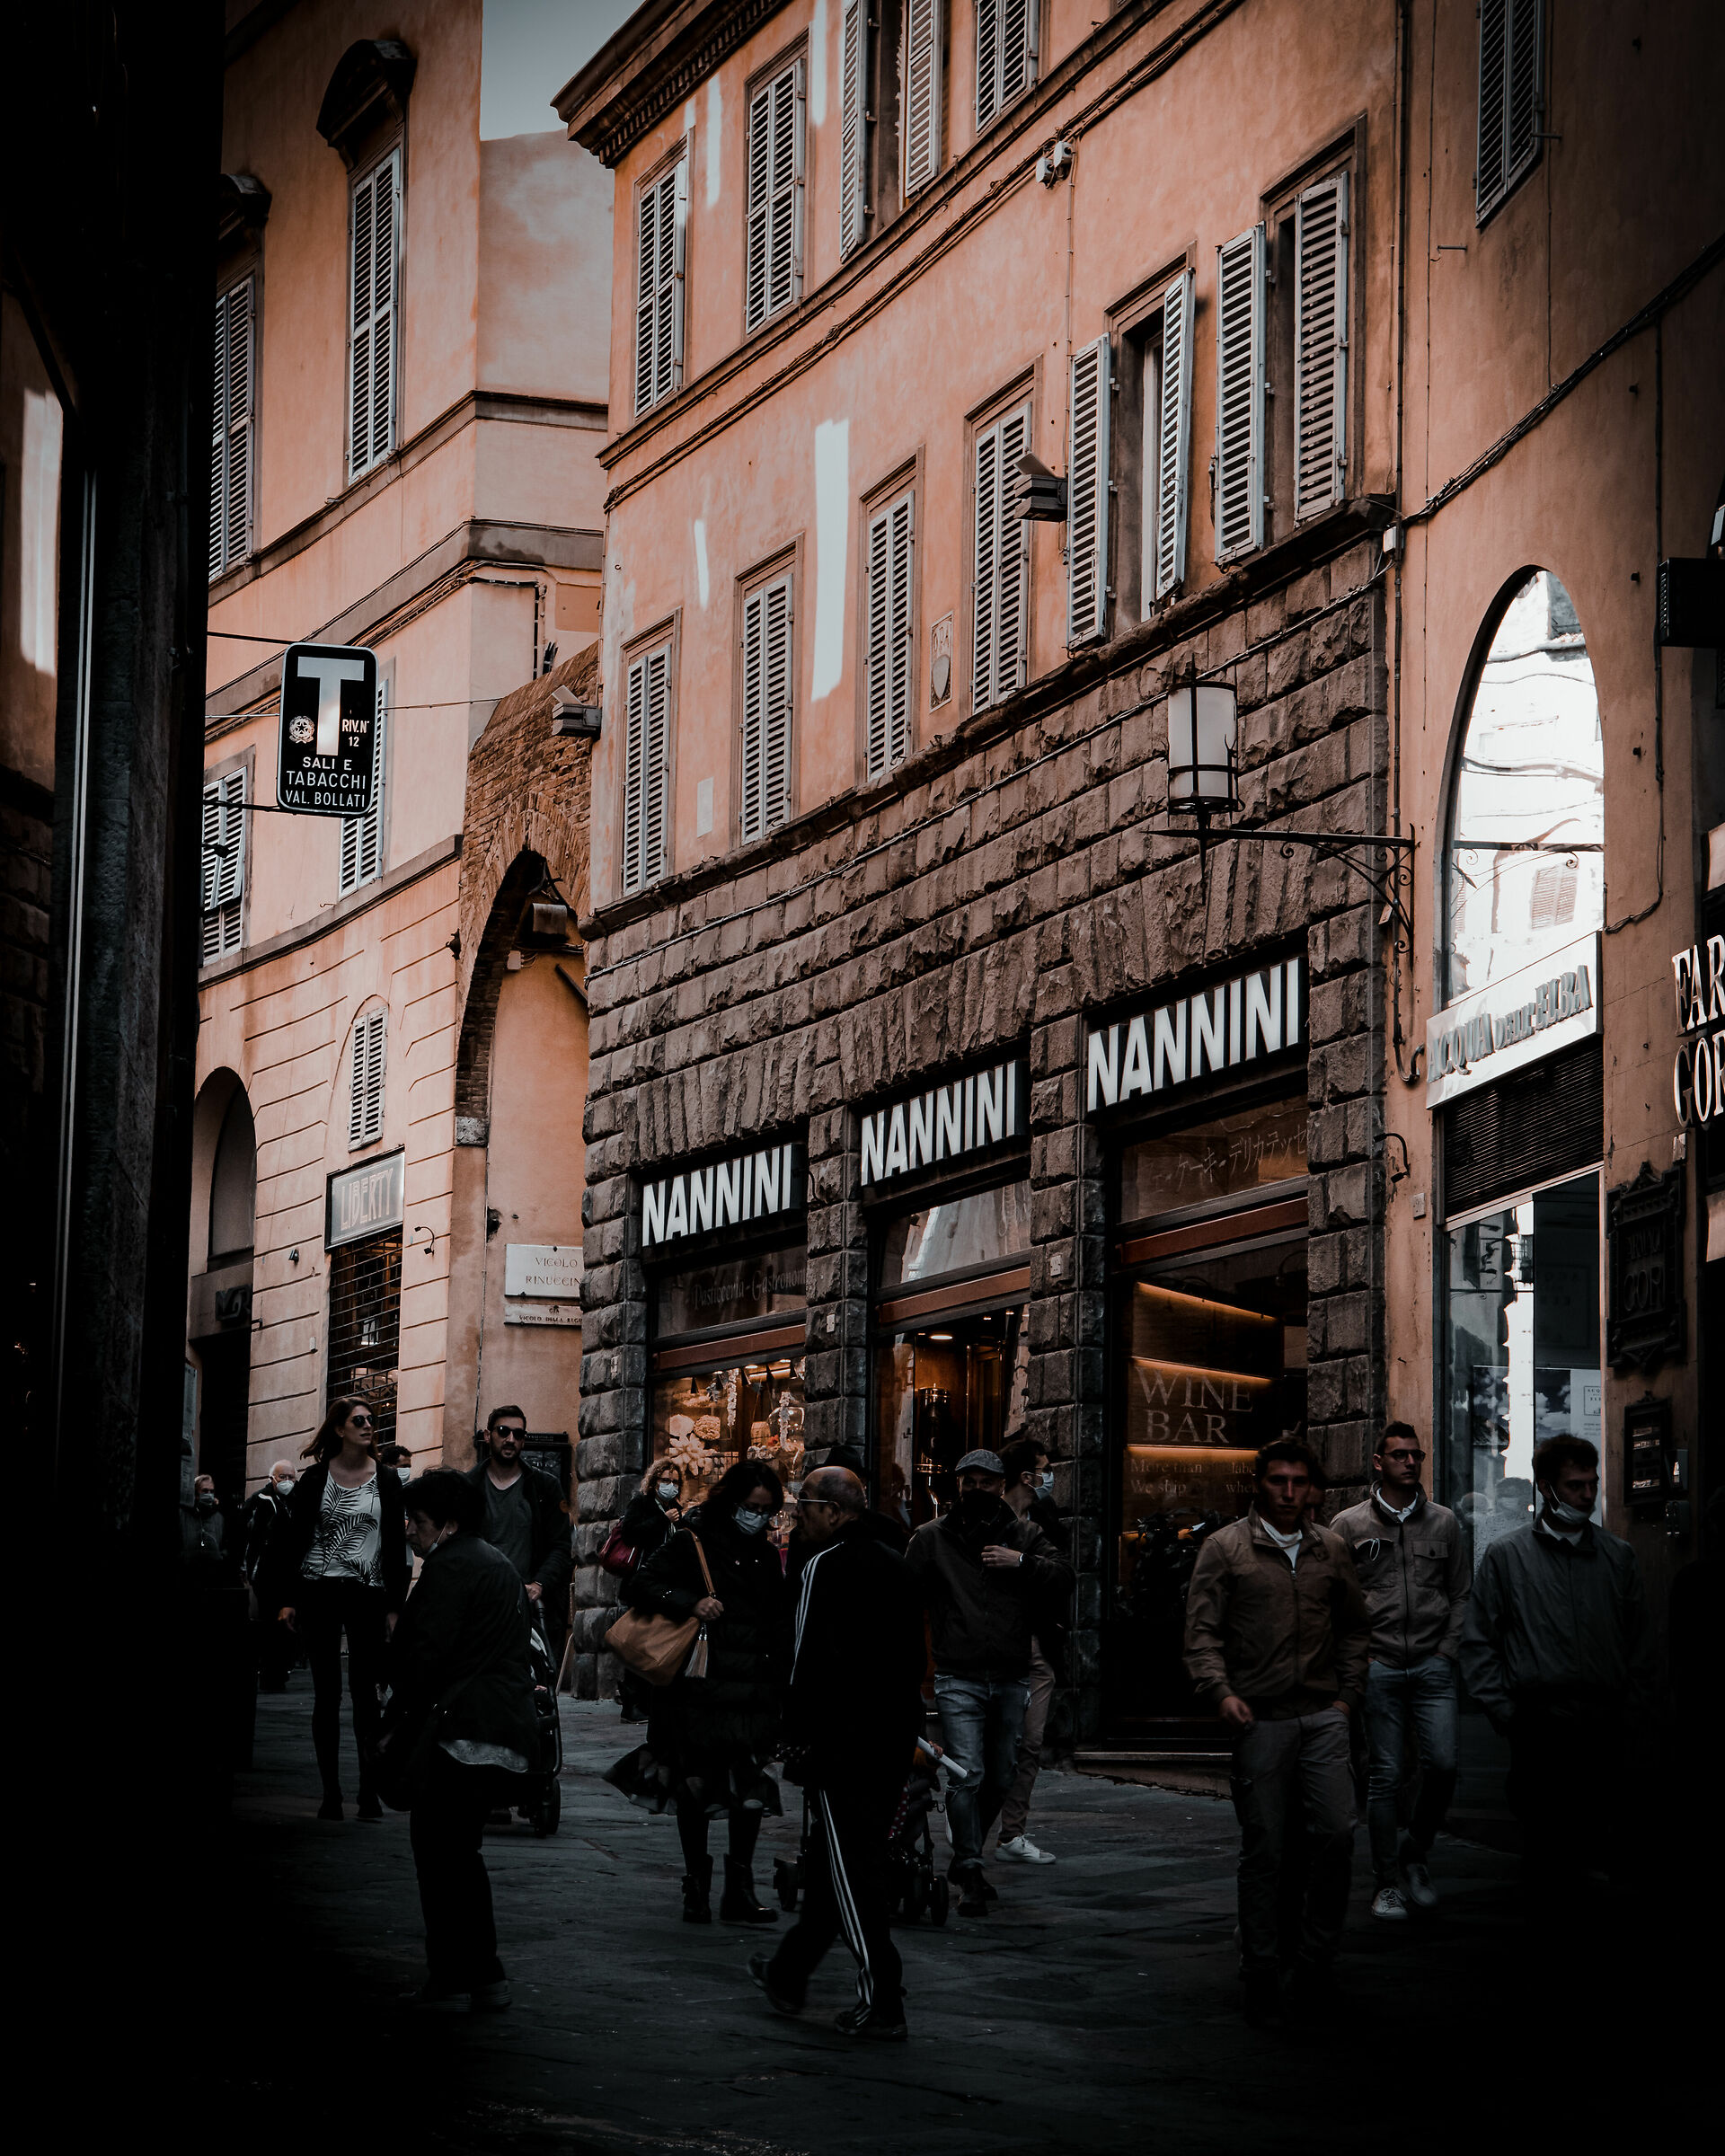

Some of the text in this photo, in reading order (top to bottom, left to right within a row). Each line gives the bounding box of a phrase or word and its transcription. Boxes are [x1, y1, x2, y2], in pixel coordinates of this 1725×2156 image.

[297, 656, 365, 755] T
[348, 736, 359, 747] 12
[287, 771, 366, 790] TABACCHI
[302, 756, 352, 771] SALI E
[286, 790, 365, 808] VAL. BOLLATI
[1087, 957, 1301, 1113] NANNINI
[1427, 1013, 1495, 1083] ACQUA
[861, 1059, 1018, 1187] NANNINI
[341, 1168, 394, 1231] LIBERTY
[642, 1143, 792, 1247] NANNINI
[535, 1258, 578, 1268] VICOLO
[1135, 1366, 1254, 1413] WINE
[1144, 1409, 1230, 1444] BAR
[1130, 1458, 1170, 1473] More
[1173, 1460, 1202, 1473] than
[1130, 1480, 1154, 1494] We
[1157, 1479, 1186, 1496] ship
